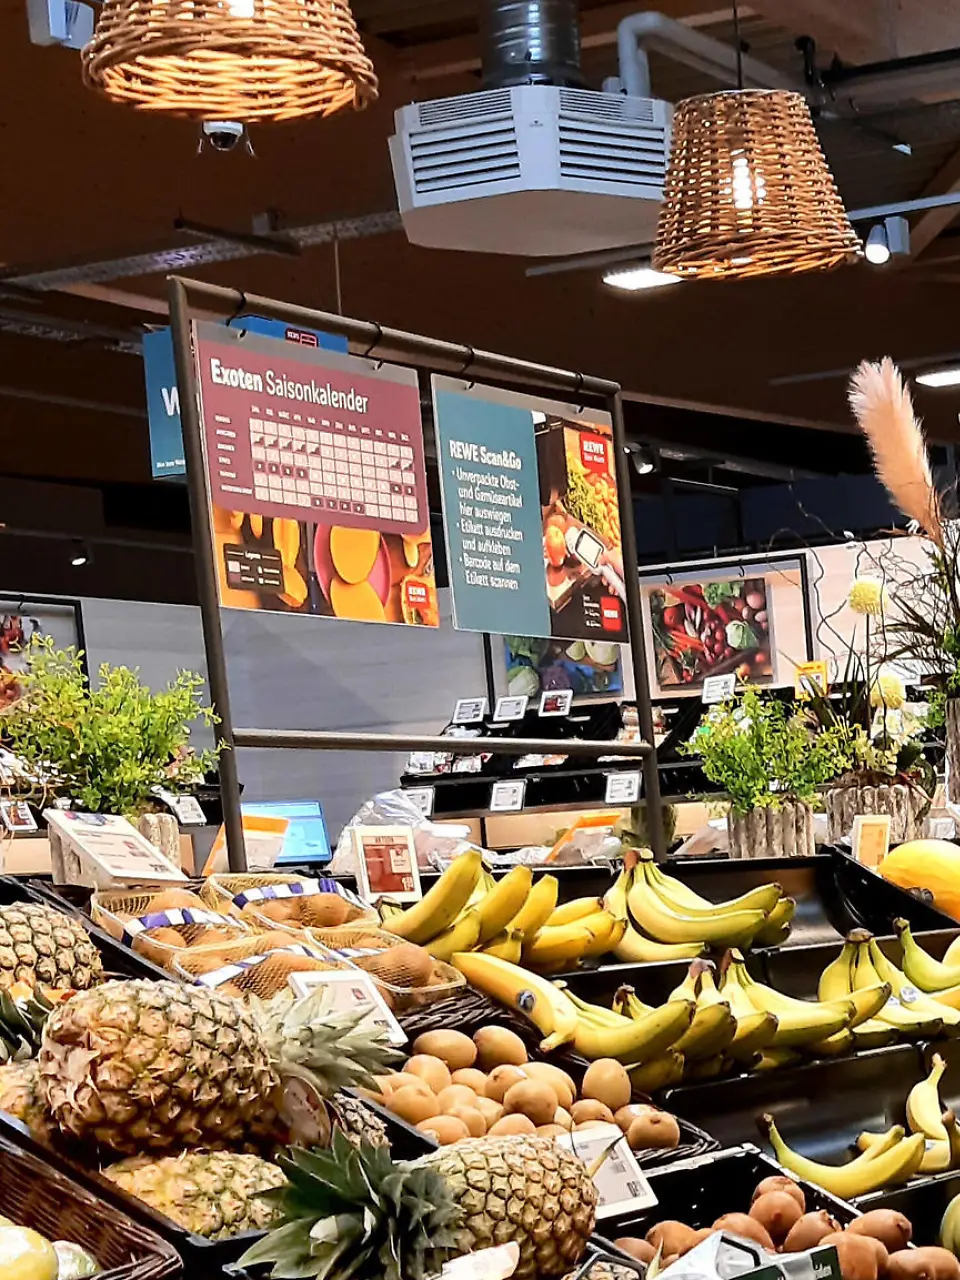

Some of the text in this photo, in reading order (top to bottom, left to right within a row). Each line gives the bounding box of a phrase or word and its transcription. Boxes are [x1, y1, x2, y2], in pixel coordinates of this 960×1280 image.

[209, 357, 369, 414] Exoten Saisonkalender
[449, 440, 522, 470] REWE Scan&Go
[456, 466, 520, 491] Unverpackte Obst-
[458, 485, 523, 508] und Gemüseartikel
[460, 501, 513, 525] hier auswiegen
[461, 518, 524, 542] Etikett ausdrucken
[463, 537, 512, 556] und aufkleben
[463, 552, 521, 574] Barcode auf dem
[465, 569, 519, 590] Etikett scannen
